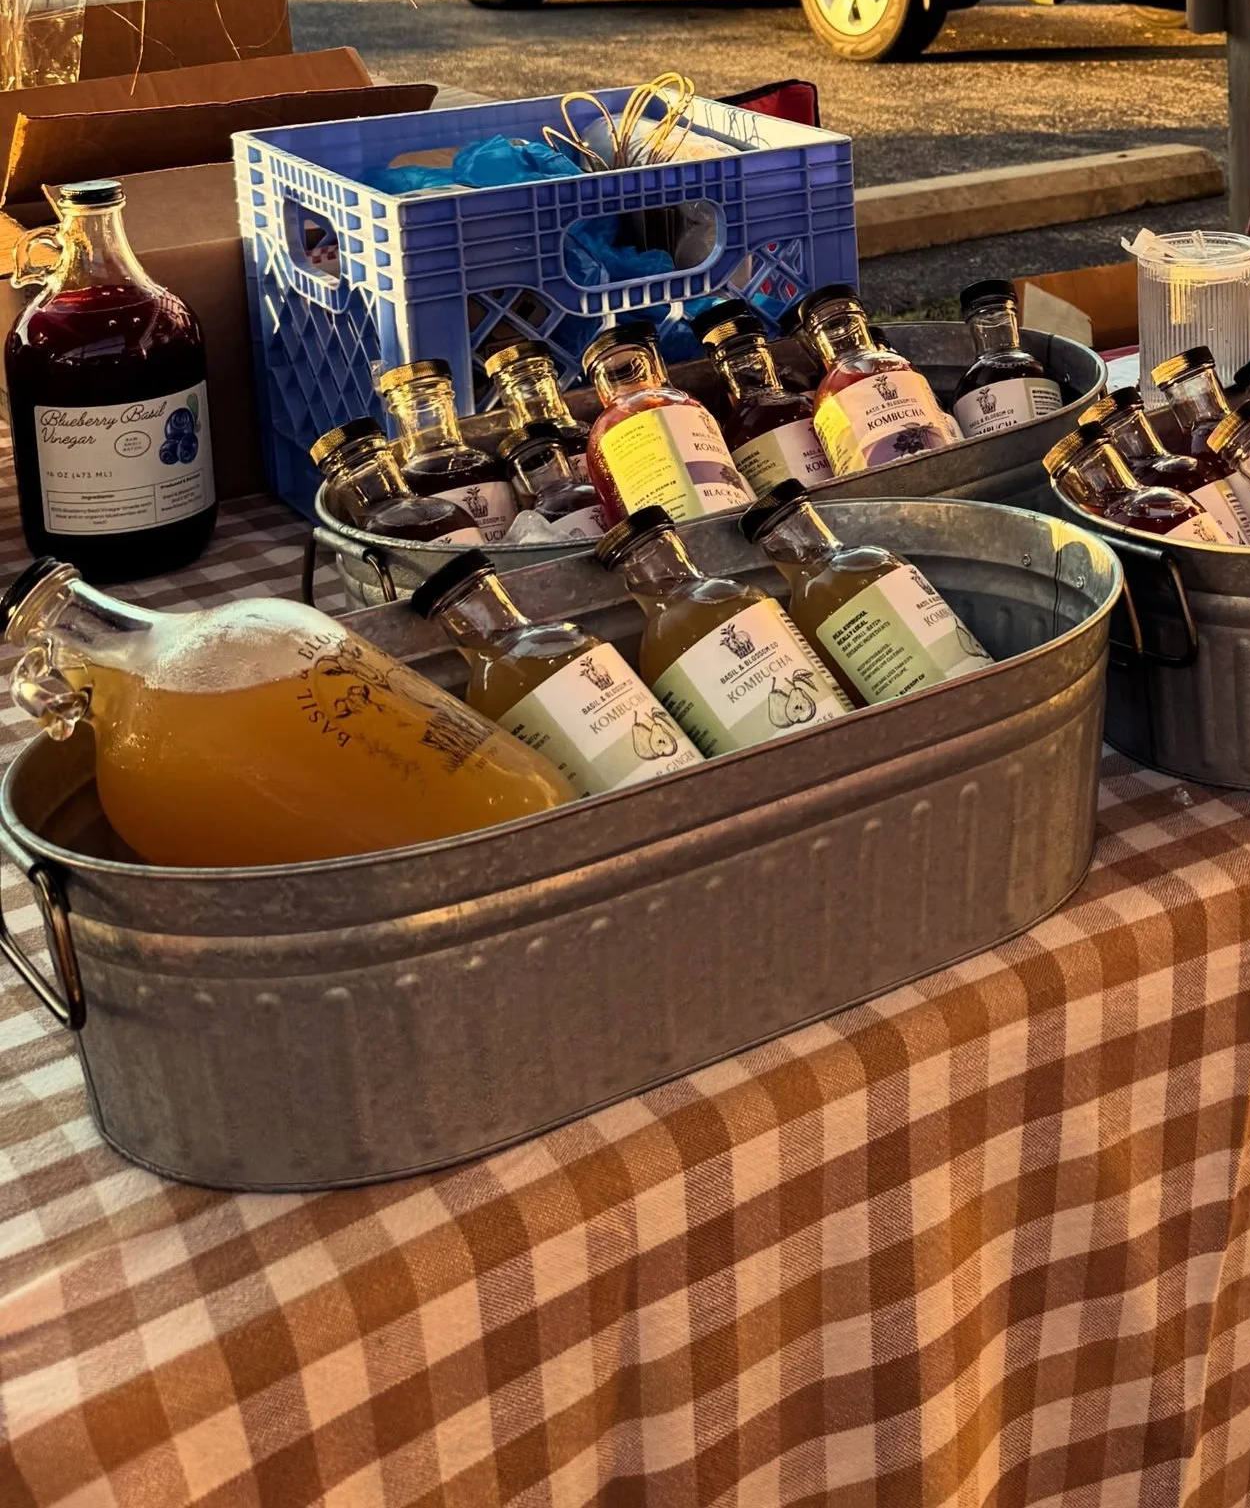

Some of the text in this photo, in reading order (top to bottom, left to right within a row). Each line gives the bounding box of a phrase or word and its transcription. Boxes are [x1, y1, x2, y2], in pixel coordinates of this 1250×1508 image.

[40, 401, 167, 430] Blueberry Basil
[867, 409, 925, 431] KOMBUCHA
[41, 427, 97, 449] Vinegar
[720, 670, 738, 685] BASIL
[744, 648, 770, 667] BLOSSOM
[771, 641, 779, 650] CO
[726, 654, 793, 704] KOMBUCHA
[581, 700, 600, 715] BASIL
[606, 683, 627, 700] BLOSSOM
[589, 690, 648, 735] KOMBUCHA
[297, 688, 352, 748] BASIL
[665, 750, 696, 772] GINGER
